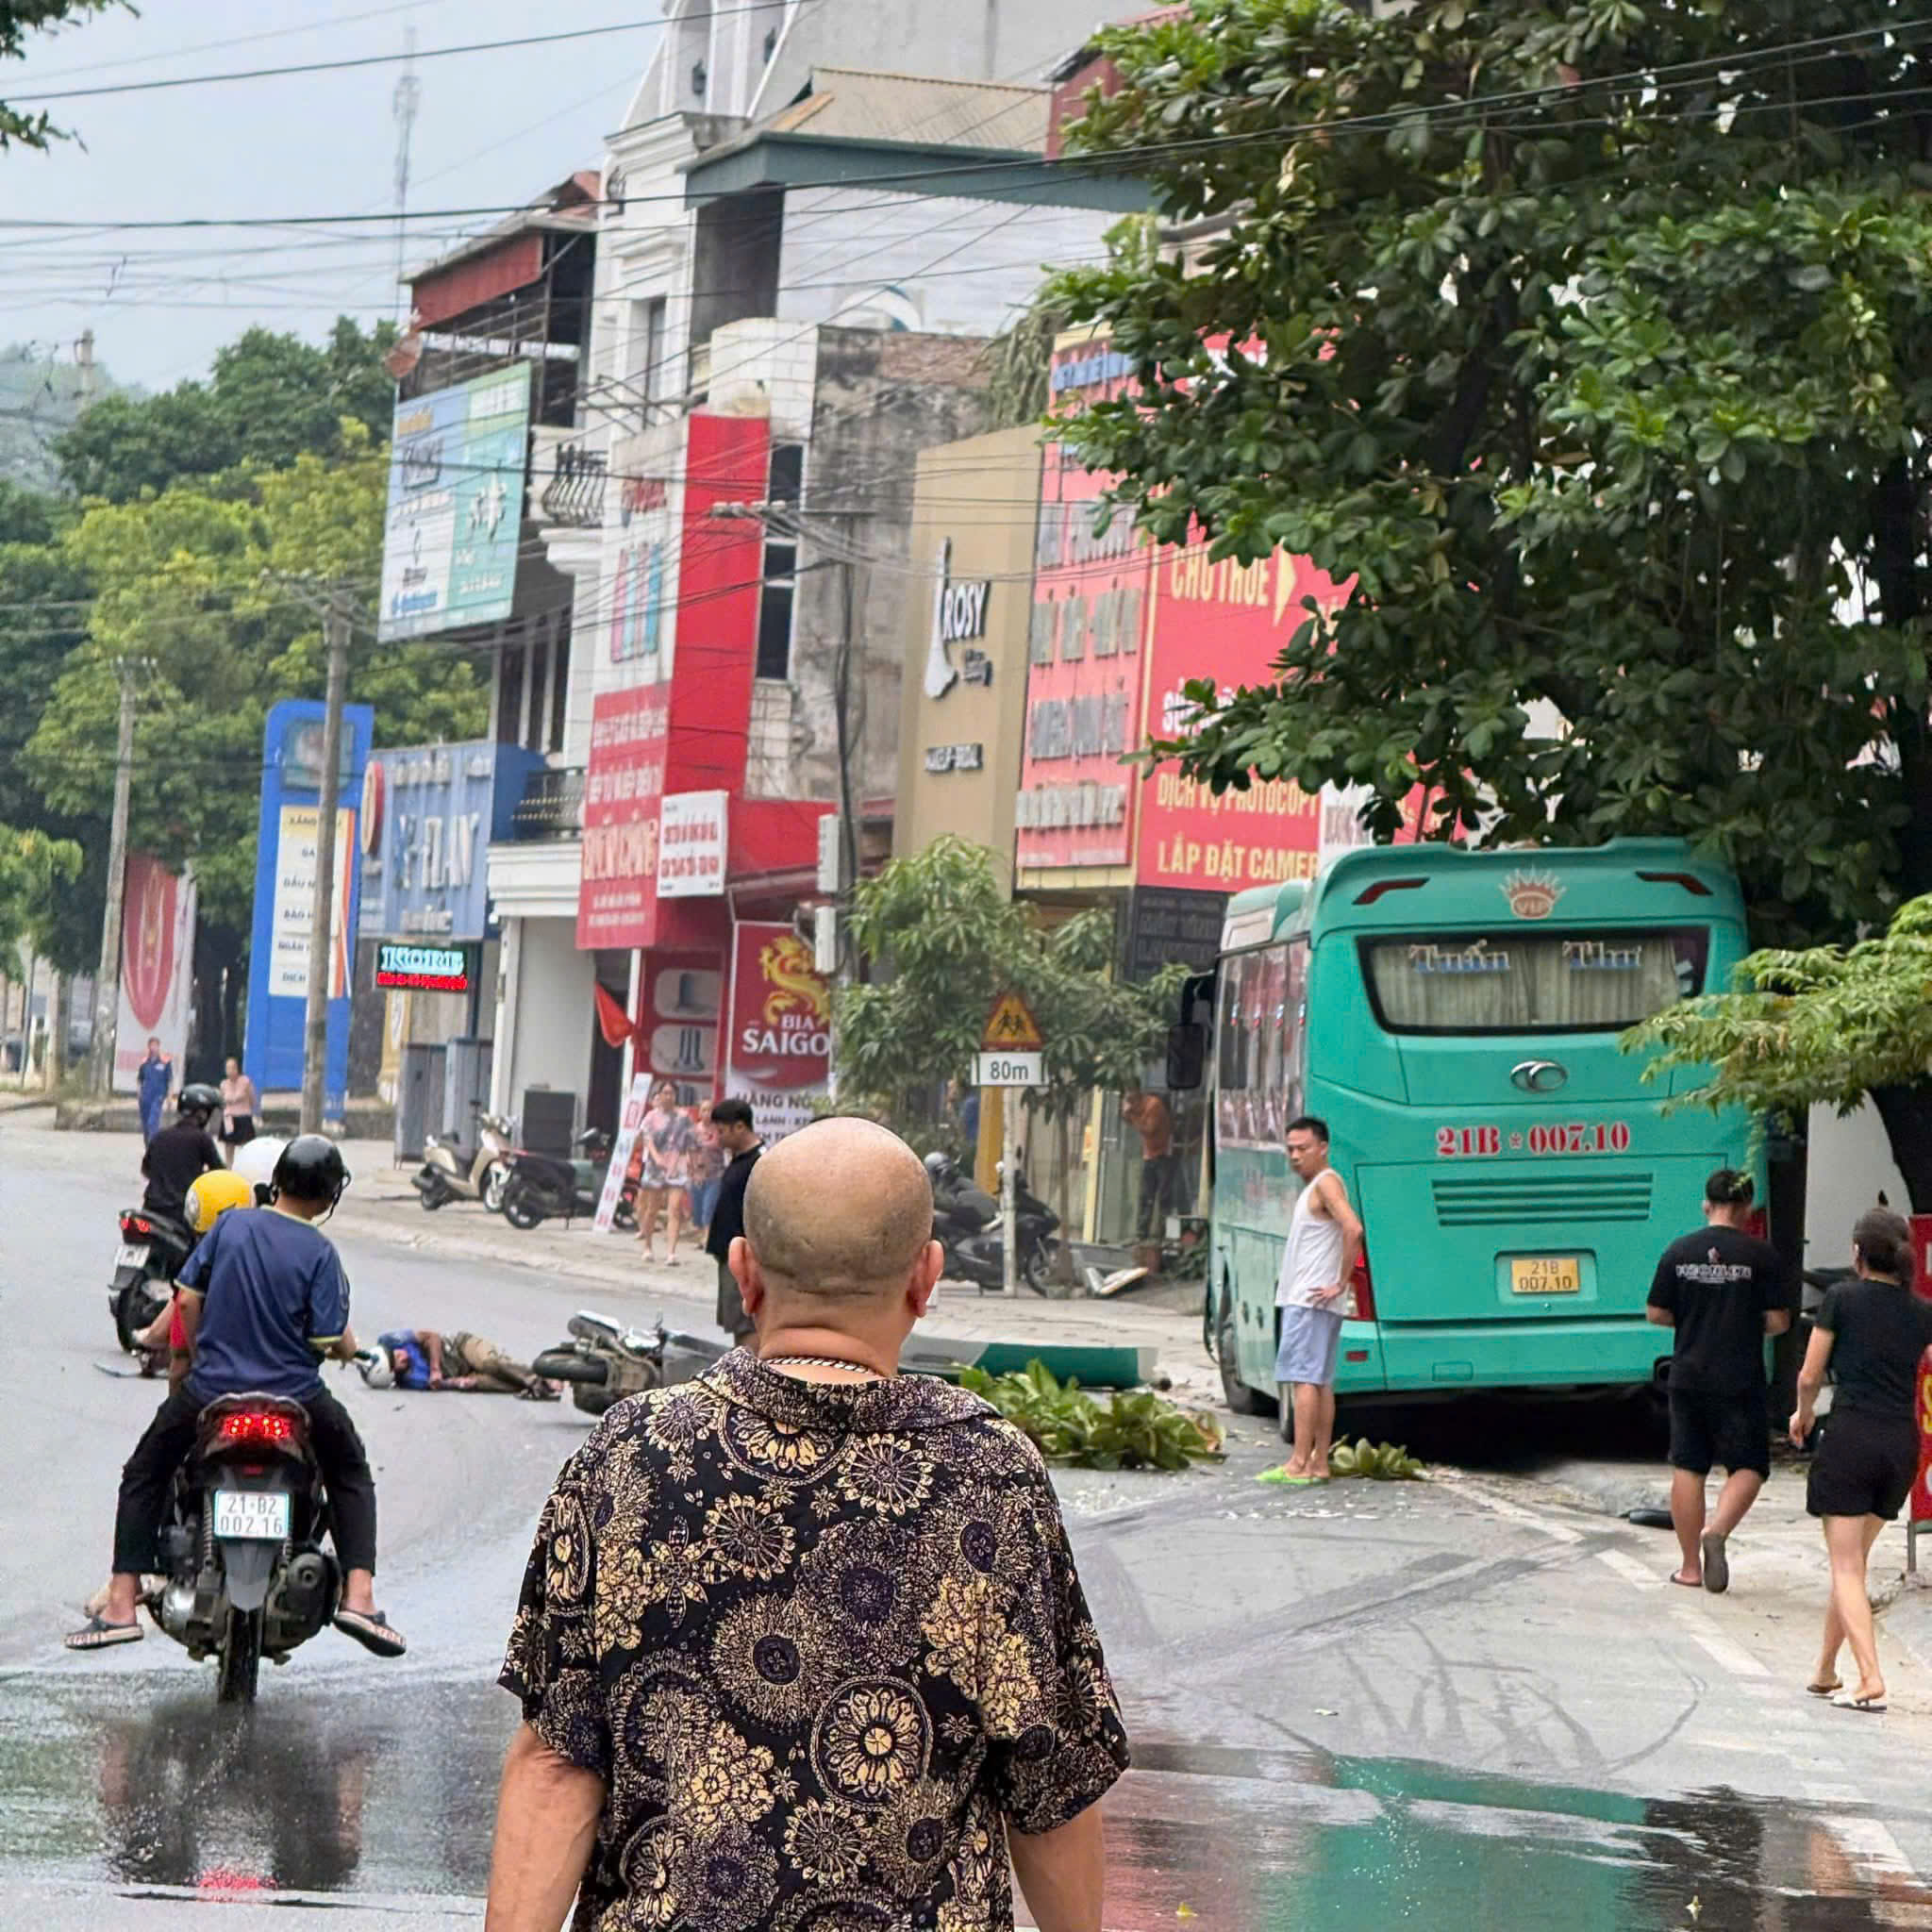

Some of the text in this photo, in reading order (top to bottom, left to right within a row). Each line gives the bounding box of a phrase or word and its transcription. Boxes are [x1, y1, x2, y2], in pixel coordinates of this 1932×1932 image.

[943, 581, 989, 641] ROSY
[1248, 849, 1319, 881] CAMER
[781, 1014, 814, 1030] BIA
[741, 1028, 830, 1056] SAIGO
[991, 1060, 1029, 1080] 80m
[1436, 1121, 1630, 1156] 21B 007.10
[1531, 1260, 1558, 1274] 21B
[1520, 1276, 1572, 1291] 007.10
